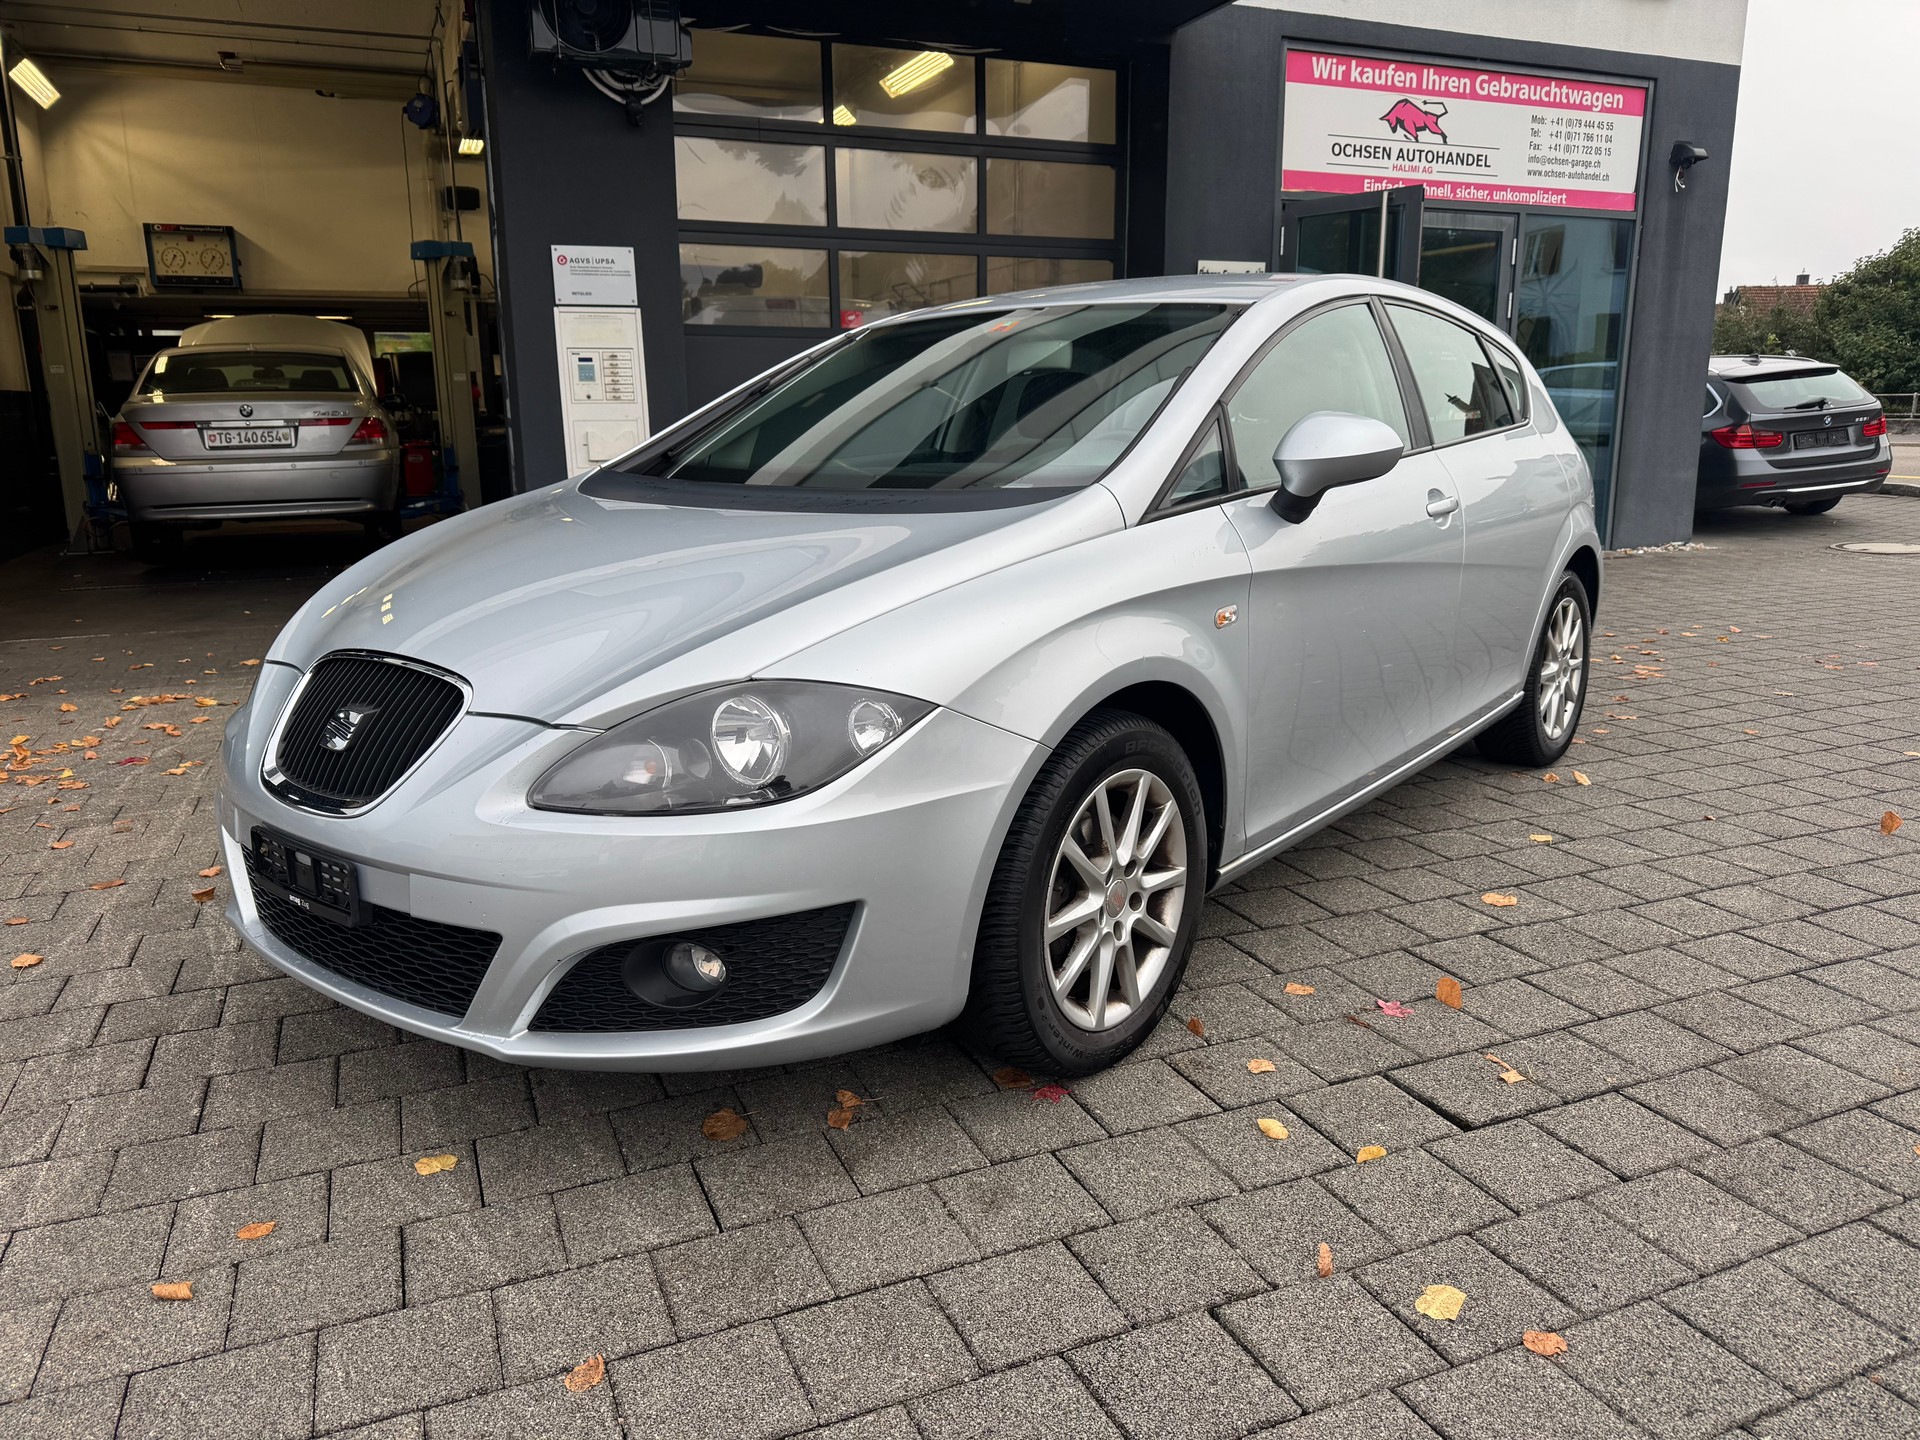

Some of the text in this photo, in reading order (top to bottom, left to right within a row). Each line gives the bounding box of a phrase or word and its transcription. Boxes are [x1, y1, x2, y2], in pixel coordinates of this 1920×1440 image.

[1311, 56, 1625, 111] Wir kaufen Ihren Gebrauchtwagen
[1531, 115, 1614, 131] Mob: +41 (0)79 444 45 55
[1530, 128, 1613, 144] Tel: +41 (0)71 766 11 04
[1331, 142, 1491, 168] OCHSEN AUTOHANDEL
[1529, 141, 1612, 156] Fax: +41 (0)71 722 05 15
[1392, 164, 1434, 174] HALIMI AG
[1528, 154, 1602, 169] info@ochsen-garage.ch
[1527, 168, 1610, 182] www.ochsen-autohandel.ch
[1364, 178, 1567, 204] Einfa hnell, sicher, unkompliziert
